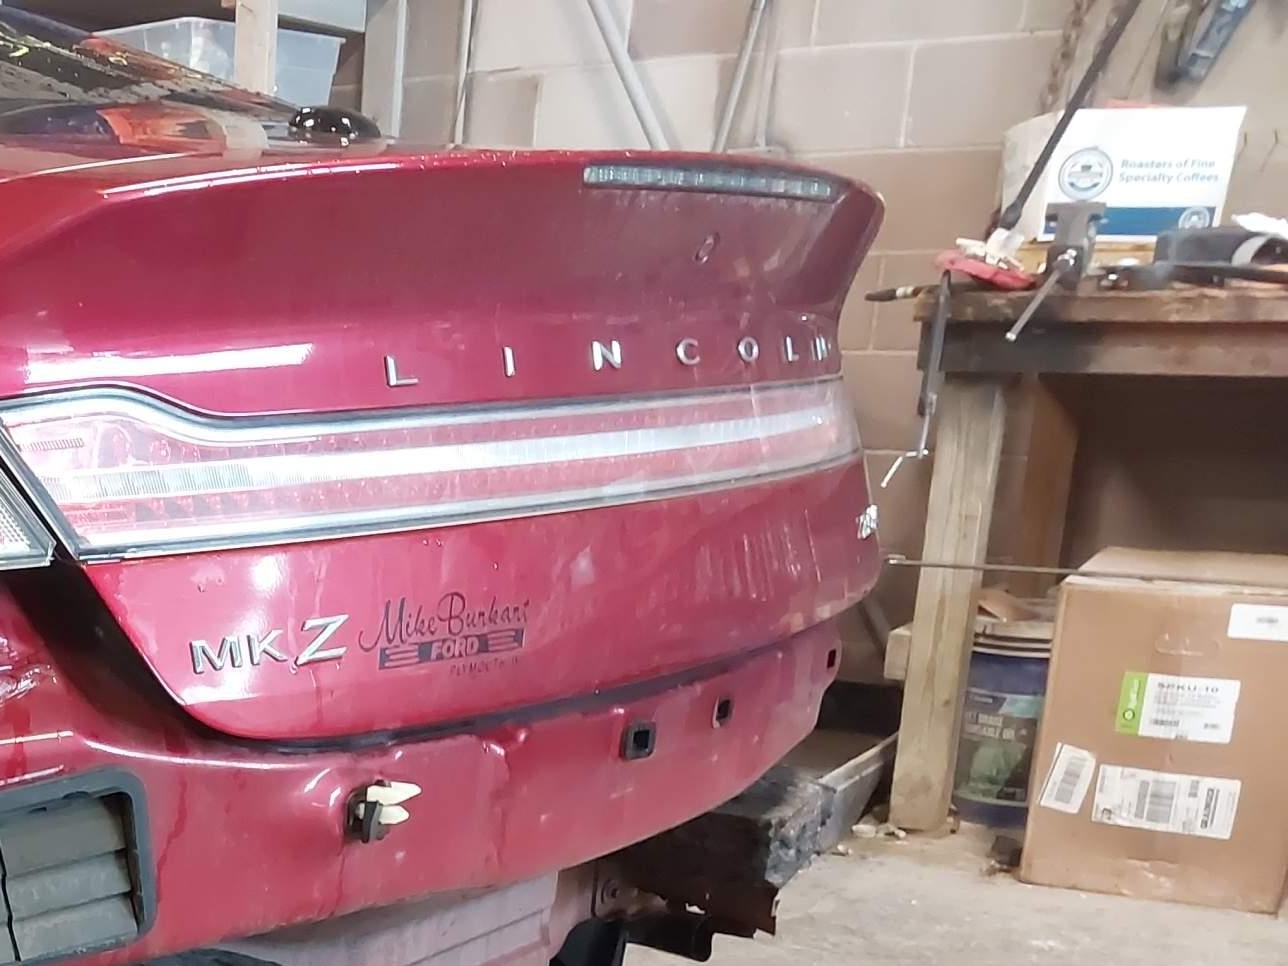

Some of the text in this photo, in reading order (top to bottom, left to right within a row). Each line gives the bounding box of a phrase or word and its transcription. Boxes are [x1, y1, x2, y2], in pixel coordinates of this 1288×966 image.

[1120, 158, 1216, 169] Roasters of Fine
[1119, 172, 1220, 185] Specialty Coffees
[384, 337, 832, 388] LINCOLN
[358, 597, 438, 653] Mike
[429, 635, 480, 660] FORD
